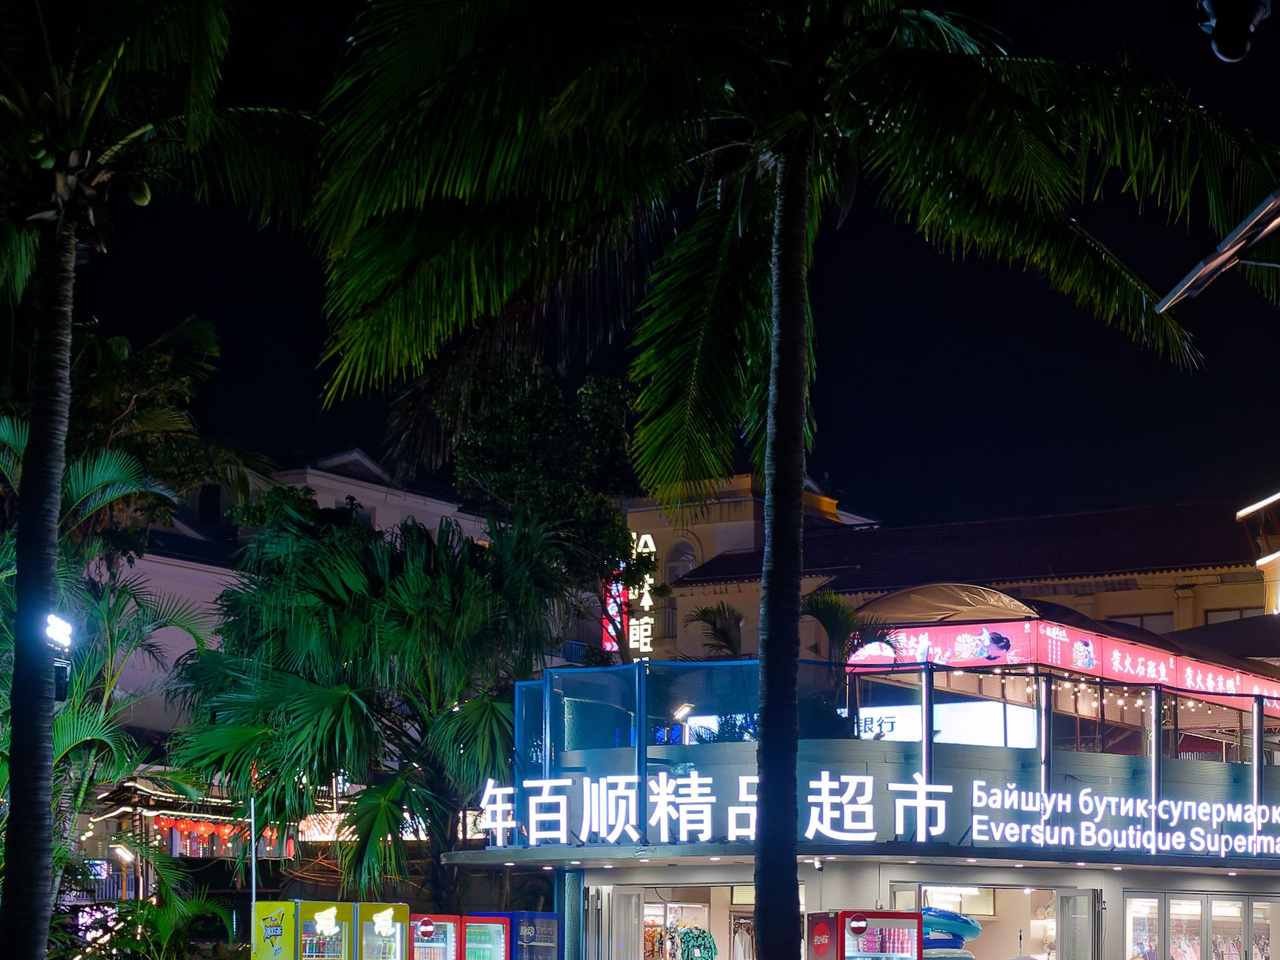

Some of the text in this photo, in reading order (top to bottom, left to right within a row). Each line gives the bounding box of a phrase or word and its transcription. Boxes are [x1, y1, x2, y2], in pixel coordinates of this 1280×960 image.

[972, 780, 1071, 814] Байшун
[971, 815, 1075, 846] Eversun
[1080, 822, 1185, 853] Boutique
